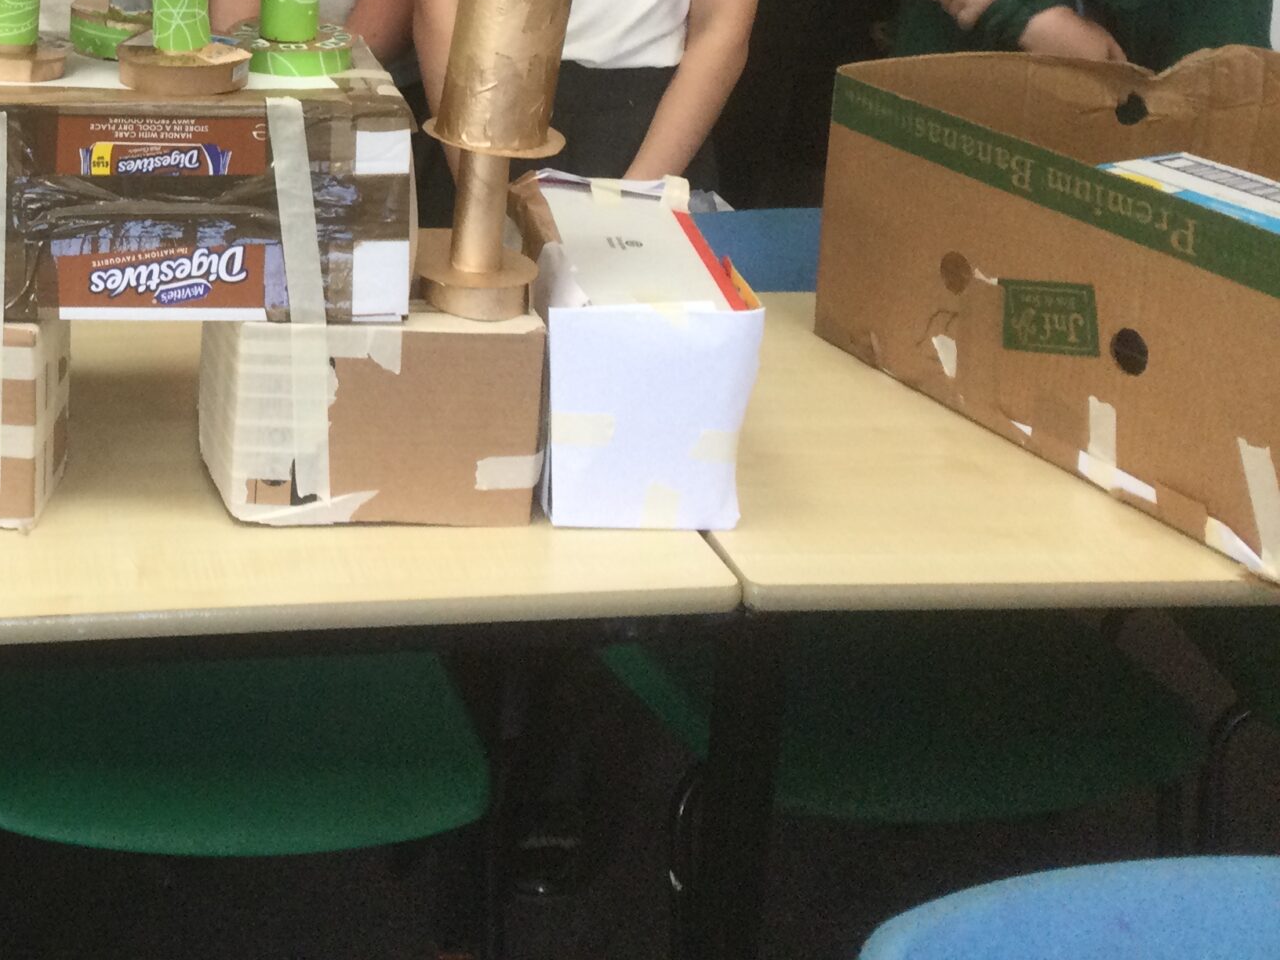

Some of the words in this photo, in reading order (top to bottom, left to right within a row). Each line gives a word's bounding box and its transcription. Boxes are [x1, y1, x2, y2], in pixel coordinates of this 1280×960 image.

[114, 131, 135, 139] CARE
[138, 131, 158, 139] WITH
[160, 131, 192, 139] HANDLE
[118, 149, 200, 173] Digestives
[915, 117, 1035, 191] Bananas
[1047, 167, 1199, 257] Premium
[91, 253, 135, 268] FAVOURITE
[90, 245, 247, 297] Digestives
[160, 284, 205, 303] McVitie's
